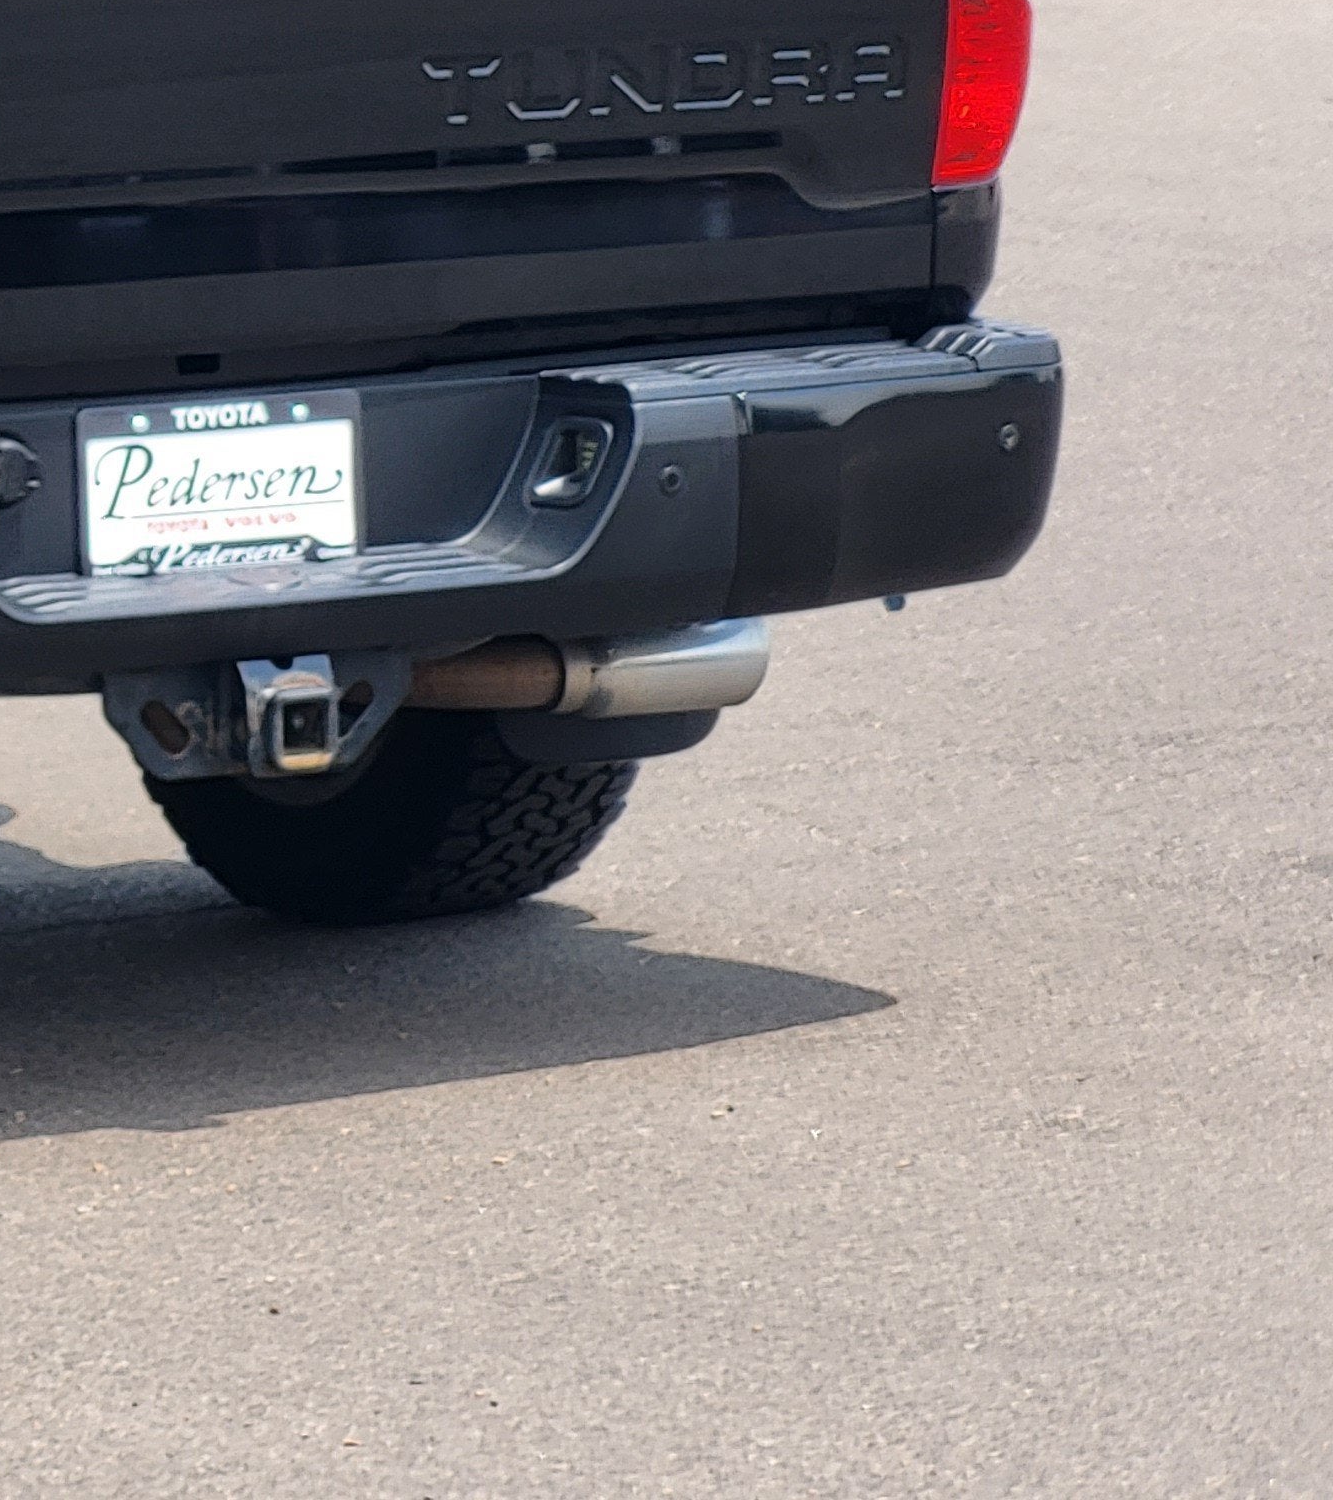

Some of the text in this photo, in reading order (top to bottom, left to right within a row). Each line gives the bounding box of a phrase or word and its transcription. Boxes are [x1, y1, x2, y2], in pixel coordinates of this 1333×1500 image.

[421, 38, 907, 124] TUNDRA
[171, 401, 270, 431] TOYOTA
[94, 443, 344, 520] Pedersen
